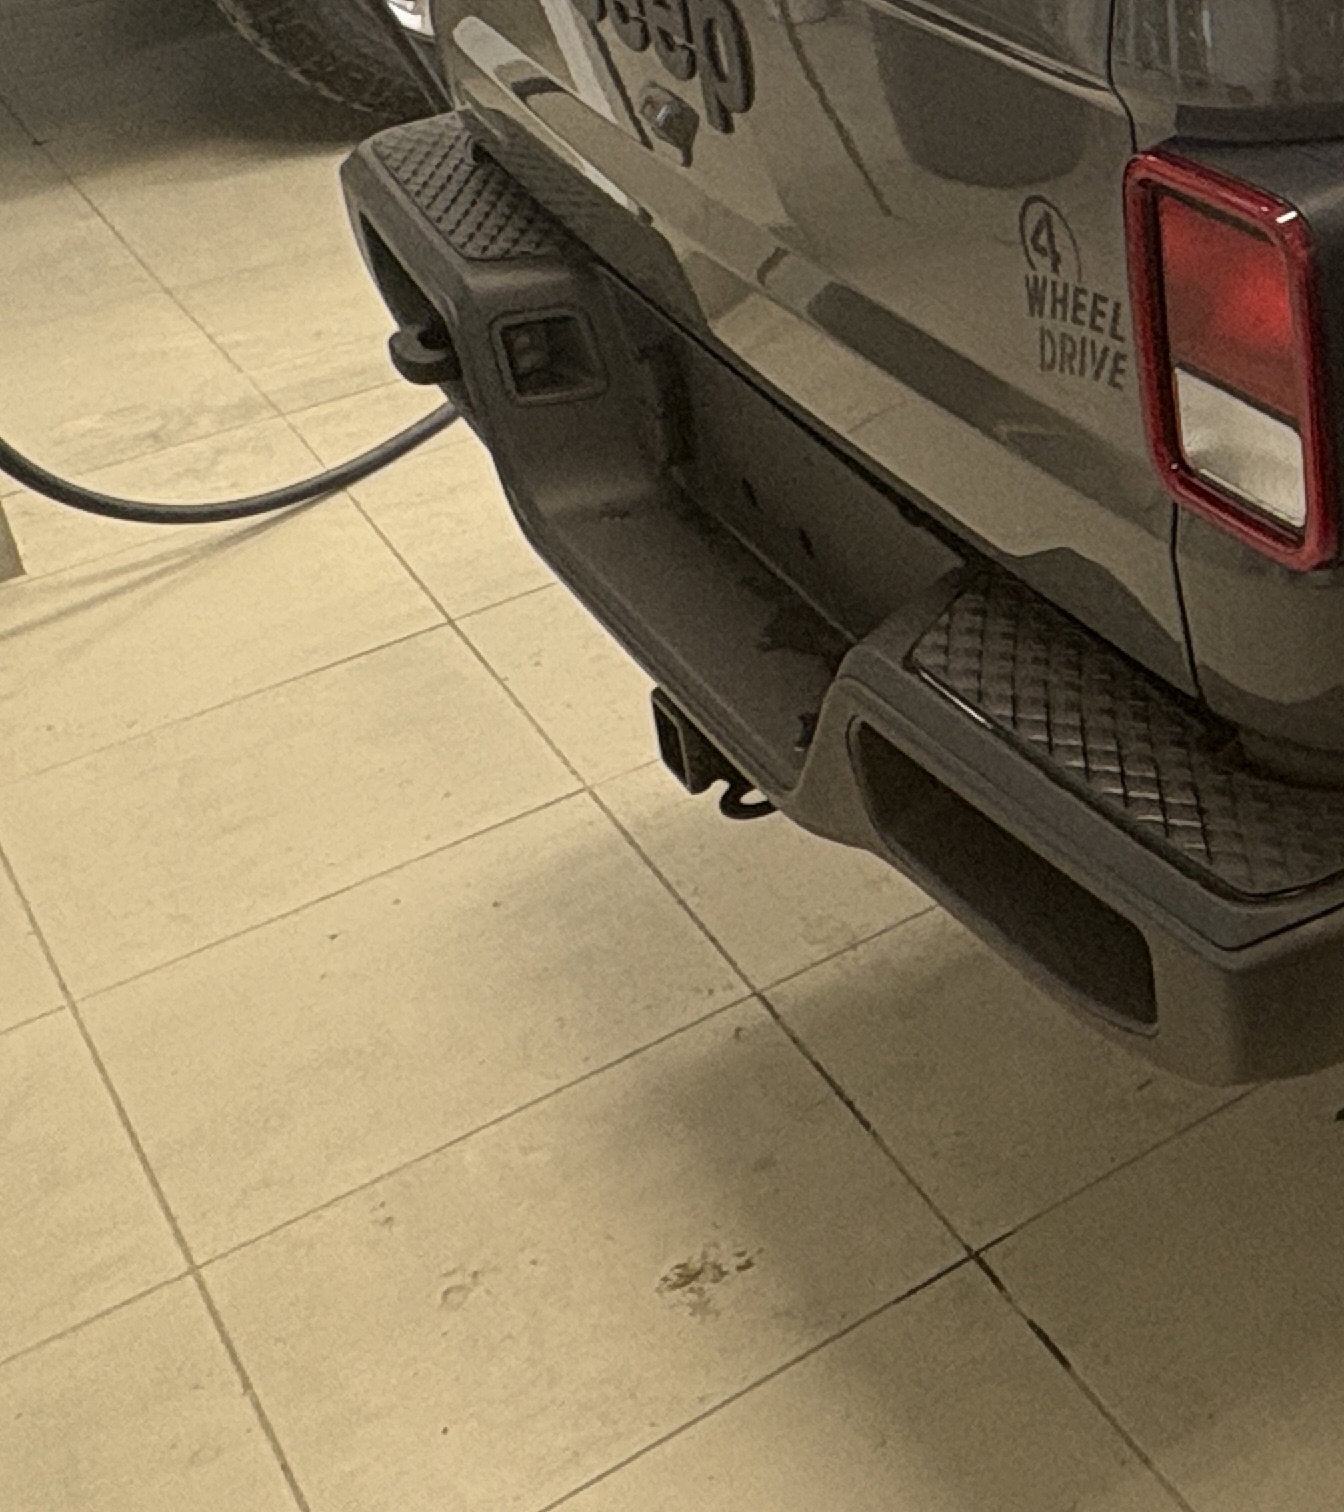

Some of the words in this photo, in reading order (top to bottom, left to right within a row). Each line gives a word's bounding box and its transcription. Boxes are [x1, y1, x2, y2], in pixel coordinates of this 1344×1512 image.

[1030, 208, 1062, 275] 4
[1024, 272, 1127, 345] WHEEL
[1037, 323, 1129, 392] DRIVE
